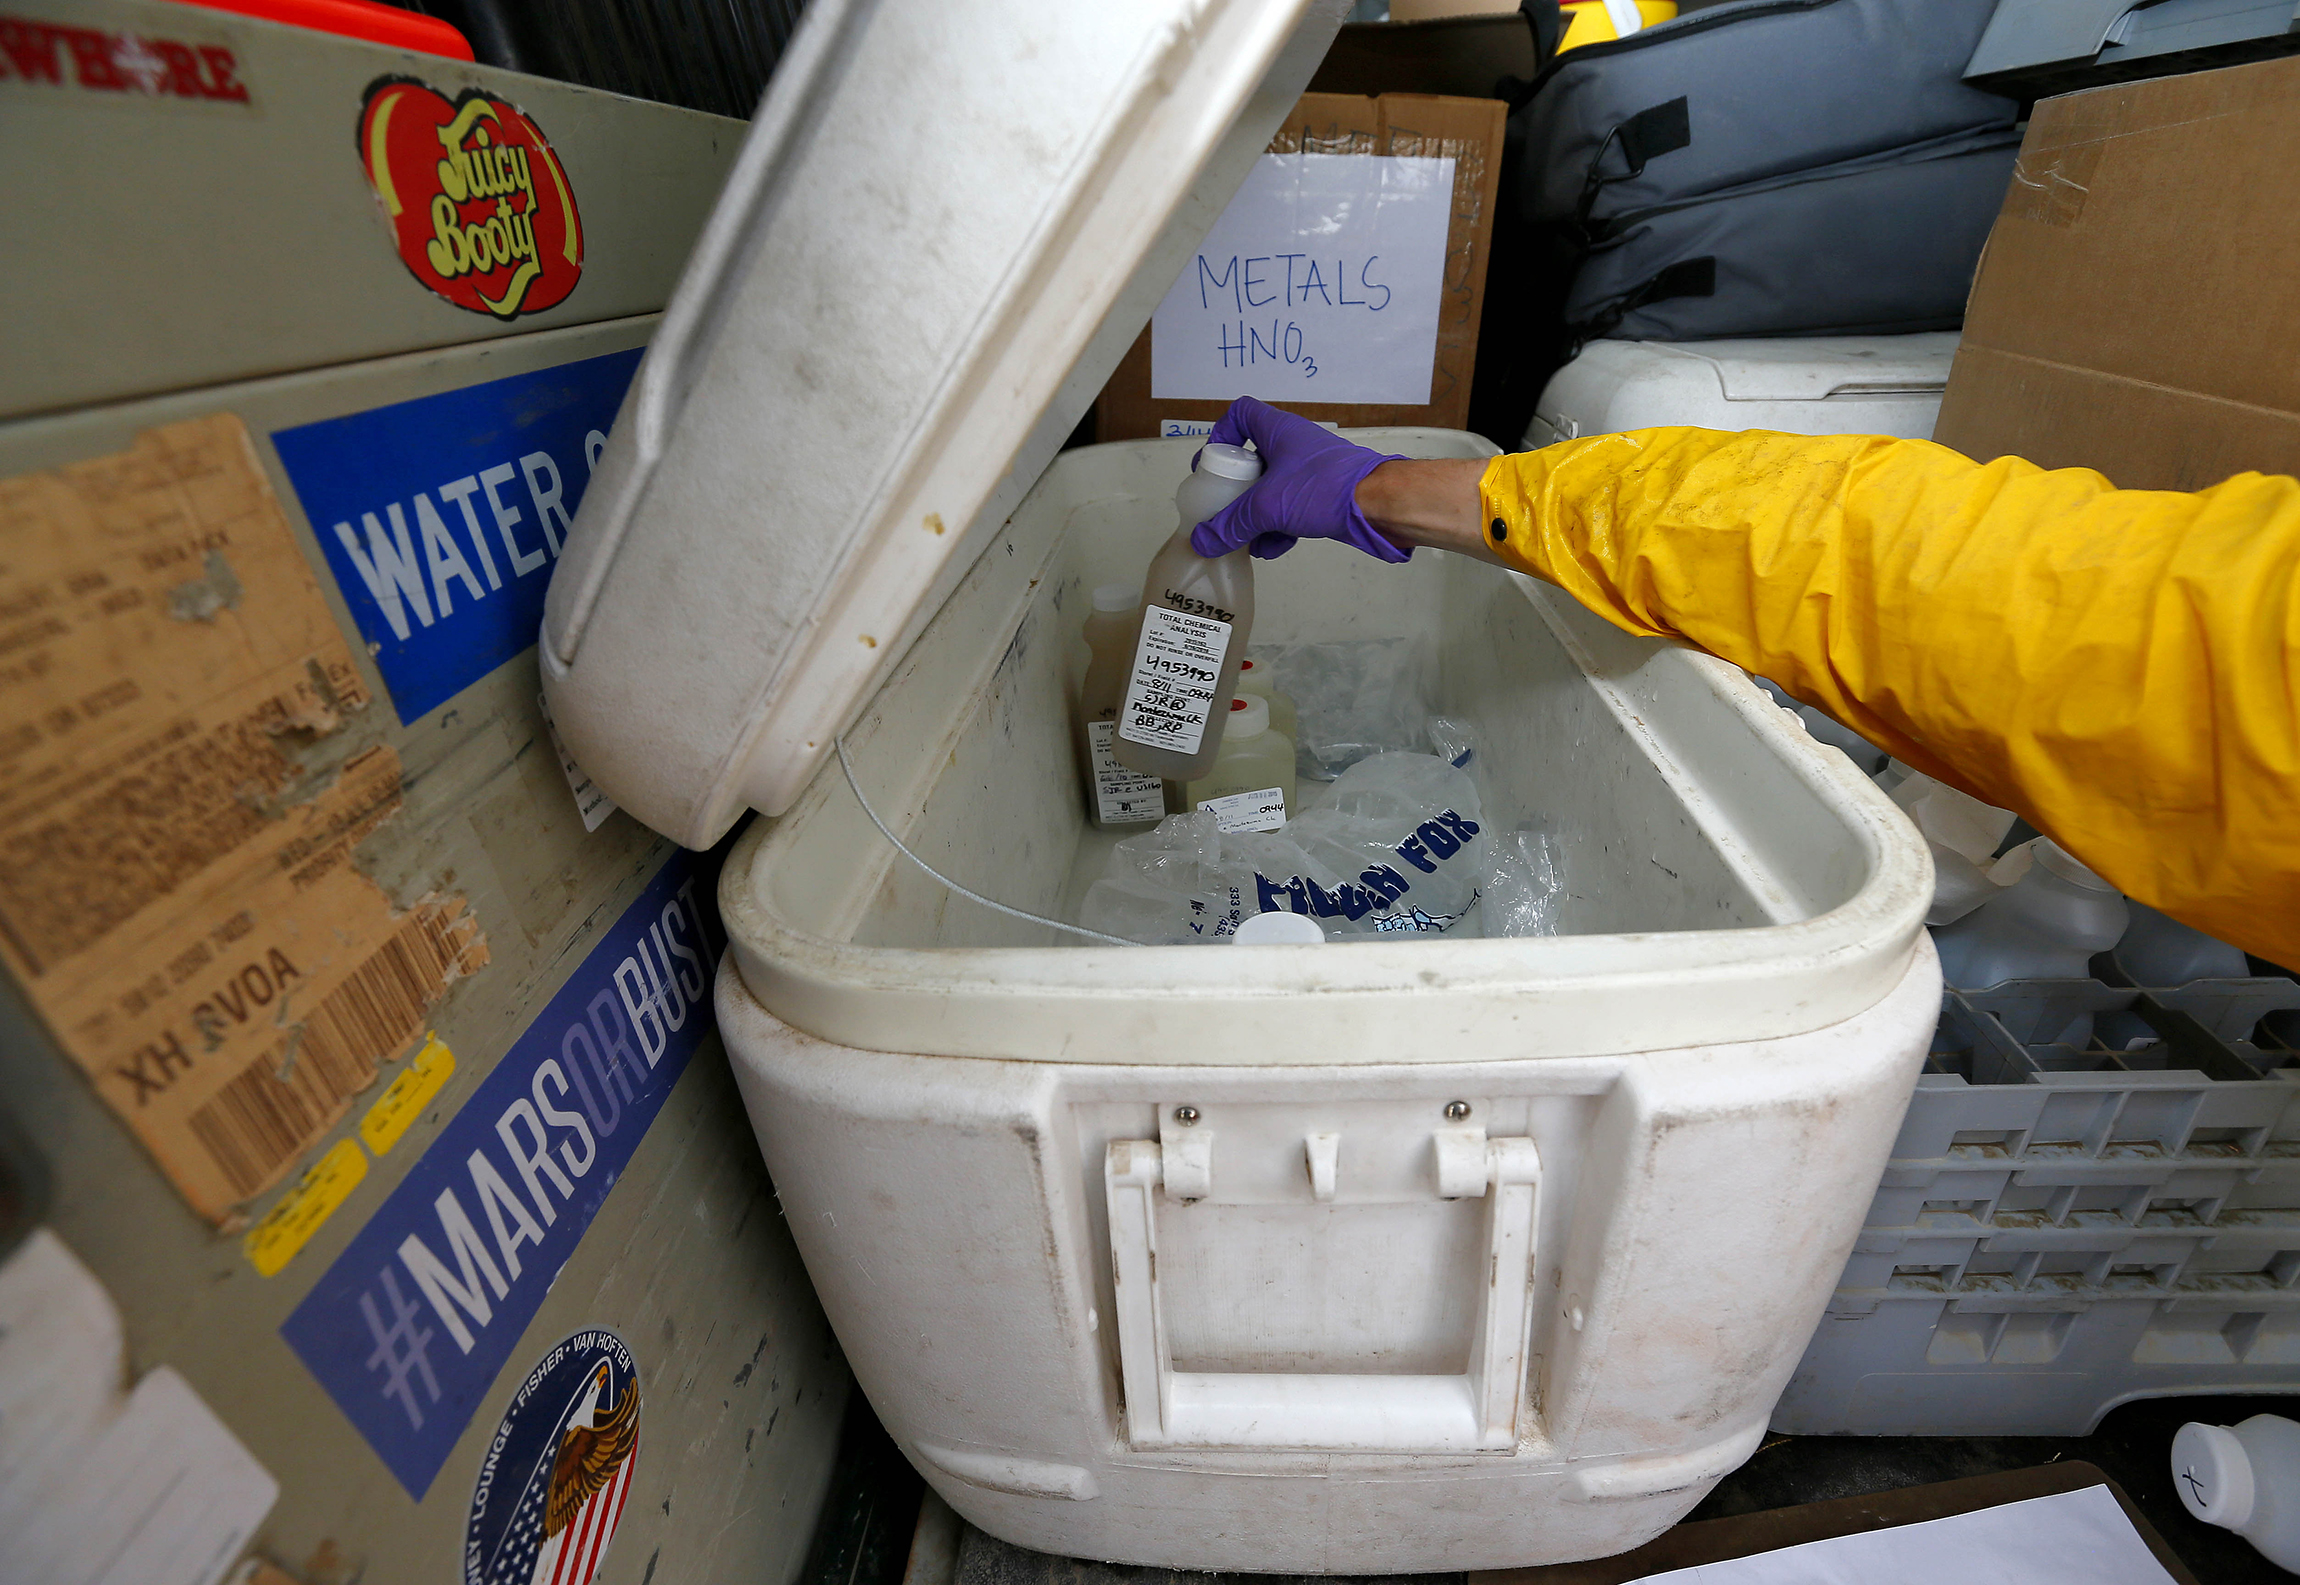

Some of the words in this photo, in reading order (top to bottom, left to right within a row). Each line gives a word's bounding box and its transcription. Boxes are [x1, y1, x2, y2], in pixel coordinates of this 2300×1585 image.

[434, 98, 539, 214] Juicy
[427, 194, 543, 315] Booty
[1198, 254, 1391, 313] METALS
[333, 450, 571, 642] WATER
[1159, 613, 1182, 625] TOTAL
[1184, 619, 1222, 633] CHEMICAL
[1169, 626, 1207, 639] ANALYSIS
[1152, 679, 1172, 693] 8/11
[1395, 808, 1480, 874] FOX
[1229, 886, 1241, 907] 333
[115, 1029, 193, 1107] XH
[572, 1331, 597, 1353] VAN
[596, 1332, 632, 1374] HOFTEN
[516, 1345, 565, 1409] FISHER
[472, 1418, 514, 1522] LOUNGE
[466, 1540, 483, 1585] VEY
